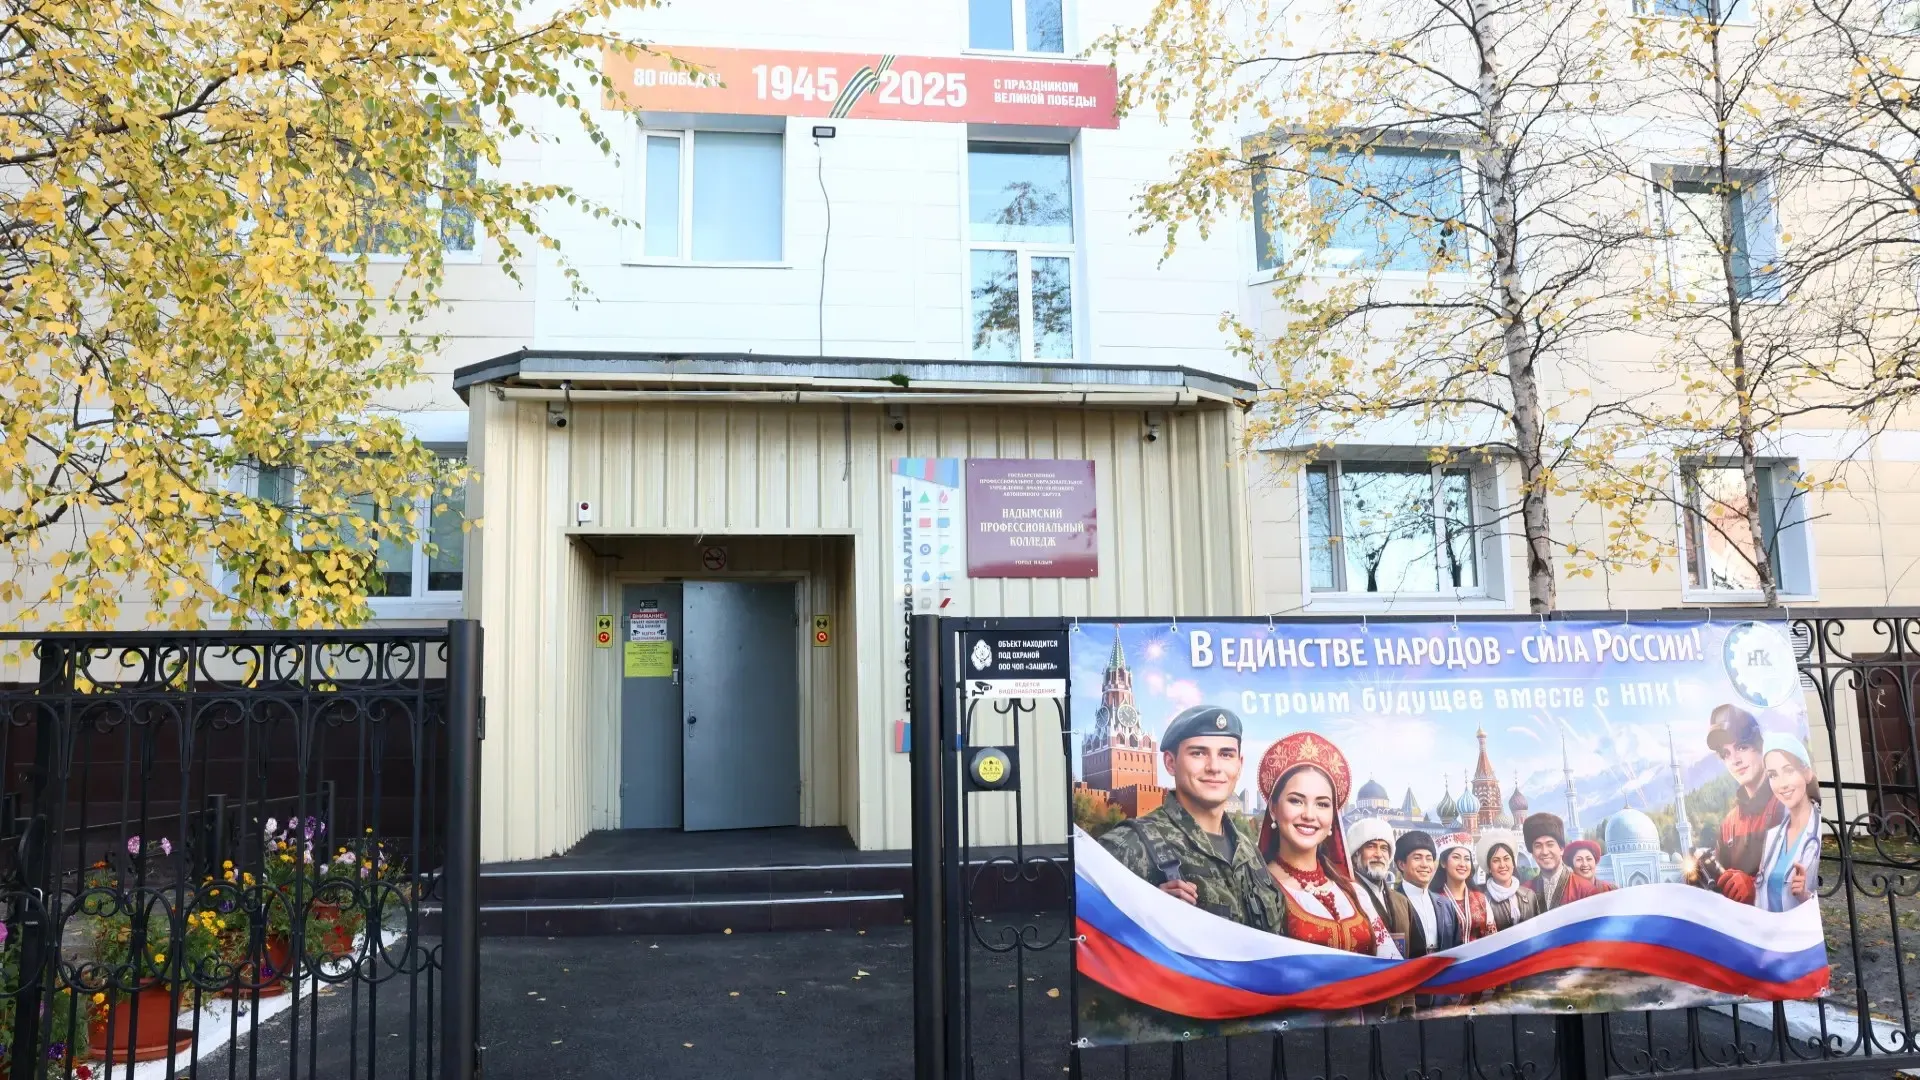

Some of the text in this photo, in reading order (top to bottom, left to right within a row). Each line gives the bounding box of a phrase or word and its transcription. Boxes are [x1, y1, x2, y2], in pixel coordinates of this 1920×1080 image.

[633, 68, 656, 87] 80
[752, 64, 839, 102] 1945
[879, 69, 968, 108] 2025
[993, 78, 1079, 93] С ПРАЗДНИКОМ
[994, 91, 1097, 108] ВЕЛИКОЙ ПОБЕДЫ!
[1002, 508, 1063, 520] НАДЫМСКИЙ
[980, 521, 1085, 533] ПРОФЕССИОНАЛЬНЫЙ
[1010, 536, 1056, 548] КОЛЛЕДЖ
[998, 640, 1058, 649] ОБЪЕКТ НАХОДИТСЯ
[1189, 630, 1214, 668] В
[1220, 637, 1368, 673] ЕДИНСТВЕ
[1374, 636, 1501, 670] НАРОДОВ
[1521, 635, 1591, 664] СИЛА
[1012, 650, 1040, 659] ОХРАНОЙ
[998, 663, 1058, 671] ООО ЧОП «ЗАЩИТА»
[1241, 689, 1350, 716] Строим
[1362, 687, 1484, 716] будущее
[1494, 686, 1585, 709] вместе
[1595, 686, 1610, 707] с
